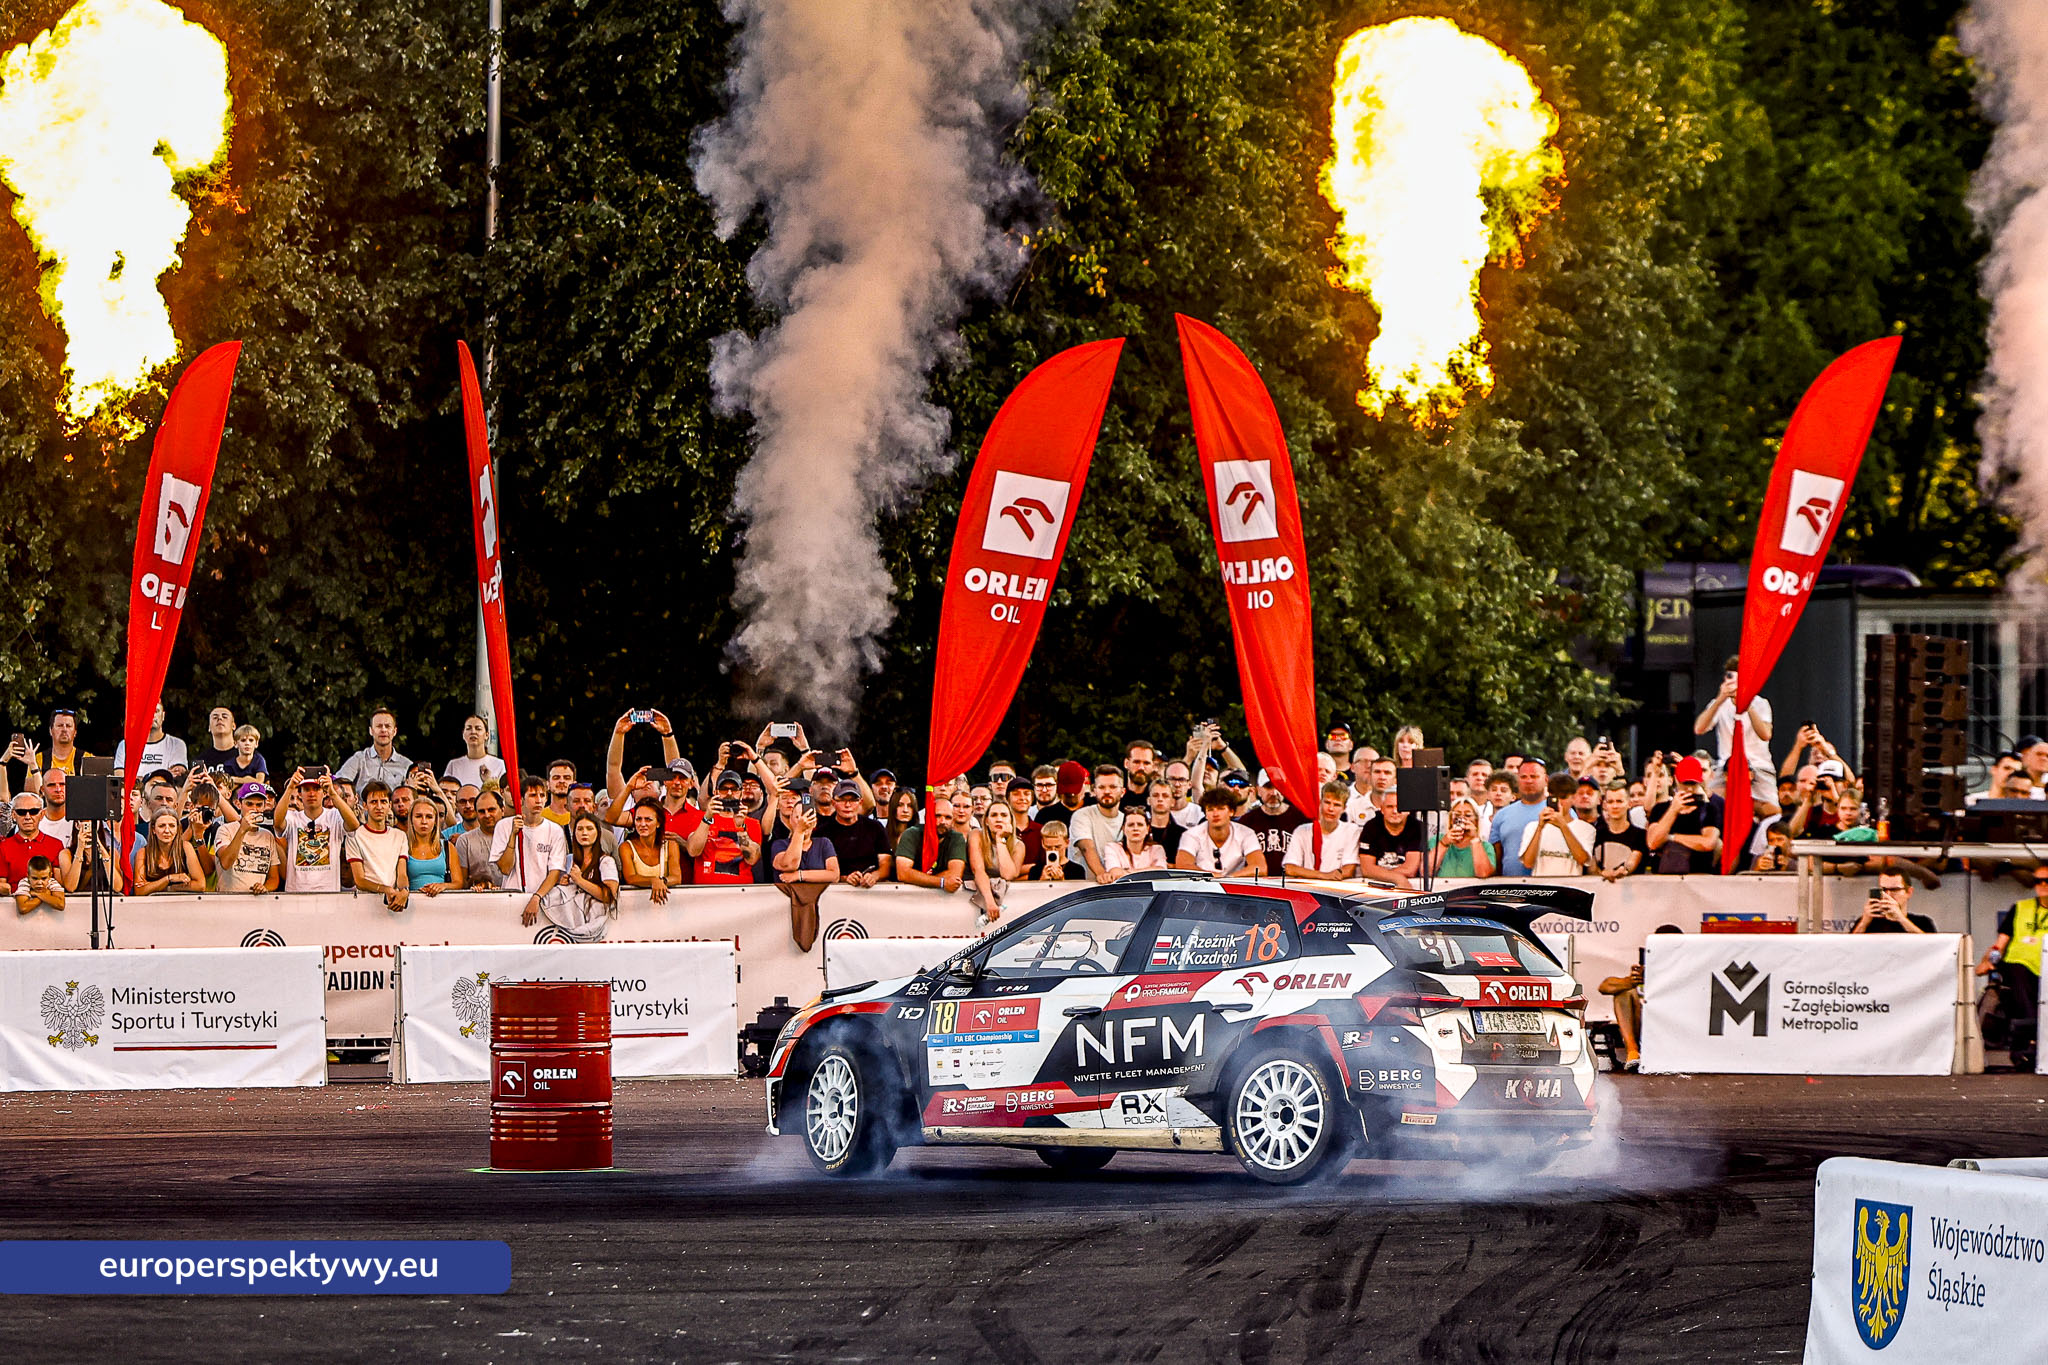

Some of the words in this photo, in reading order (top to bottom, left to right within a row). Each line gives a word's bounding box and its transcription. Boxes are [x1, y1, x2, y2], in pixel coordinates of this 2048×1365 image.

[964, 567, 1049, 602] ORLEN
[990, 603, 1021, 624] OIL
[1172, 938, 1185, 950] A.
[1189, 934, 1236, 949] Rzeźnik
[1244, 923, 1281, 961] 18
[1168, 952, 1181, 965] K.
[1184, 951, 1238, 965] Kozdroń
[325, 971, 384, 991] ADION
[1274, 973, 1352, 991] ORLEN
[1784, 980, 1870, 999] Górnośląsko
[111, 986, 236, 1005] Ministerstwo
[1142, 987, 1188, 998] PRO-FAMILIA
[1508, 985, 1548, 1001] ORLEN
[998, 1007, 1026, 1016] ORLEN
[1783, 998, 1890, 1016] -Zagłębiowska
[111, 1012, 175, 1033] Sportu
[180, 1012, 186, 1029] i
[191, 1010, 278, 1032] Turystyki
[935, 1002, 955, 1034] 18
[1782, 1016, 1859, 1034] Metropolia
[976, 1033, 1013, 1042] Championship
[1075, 1013, 1205, 1067] NFM
[533, 1068, 577, 1080] ORLEN
[1074, 1072, 1111, 1083] NIVETTE
[1115, 1069, 1140, 1079] FLEET
[1146, 1063, 1206, 1077] MANAGEMENT
[1378, 1069, 1422, 1081] BERG
[533, 1081, 551, 1091] OIL
[1378, 1082, 1422, 1090] INWESTYCJE
[1021, 1091, 1055, 1102] BERG
[1120, 1093, 1166, 1116] RX
[1020, 1103, 1055, 1111] INWESTYCJE
[1124, 1116, 1167, 1126] POLSKA
[1931, 1216, 2044, 1263] Województwo
[1927, 1261, 1985, 1312] Śląskie
